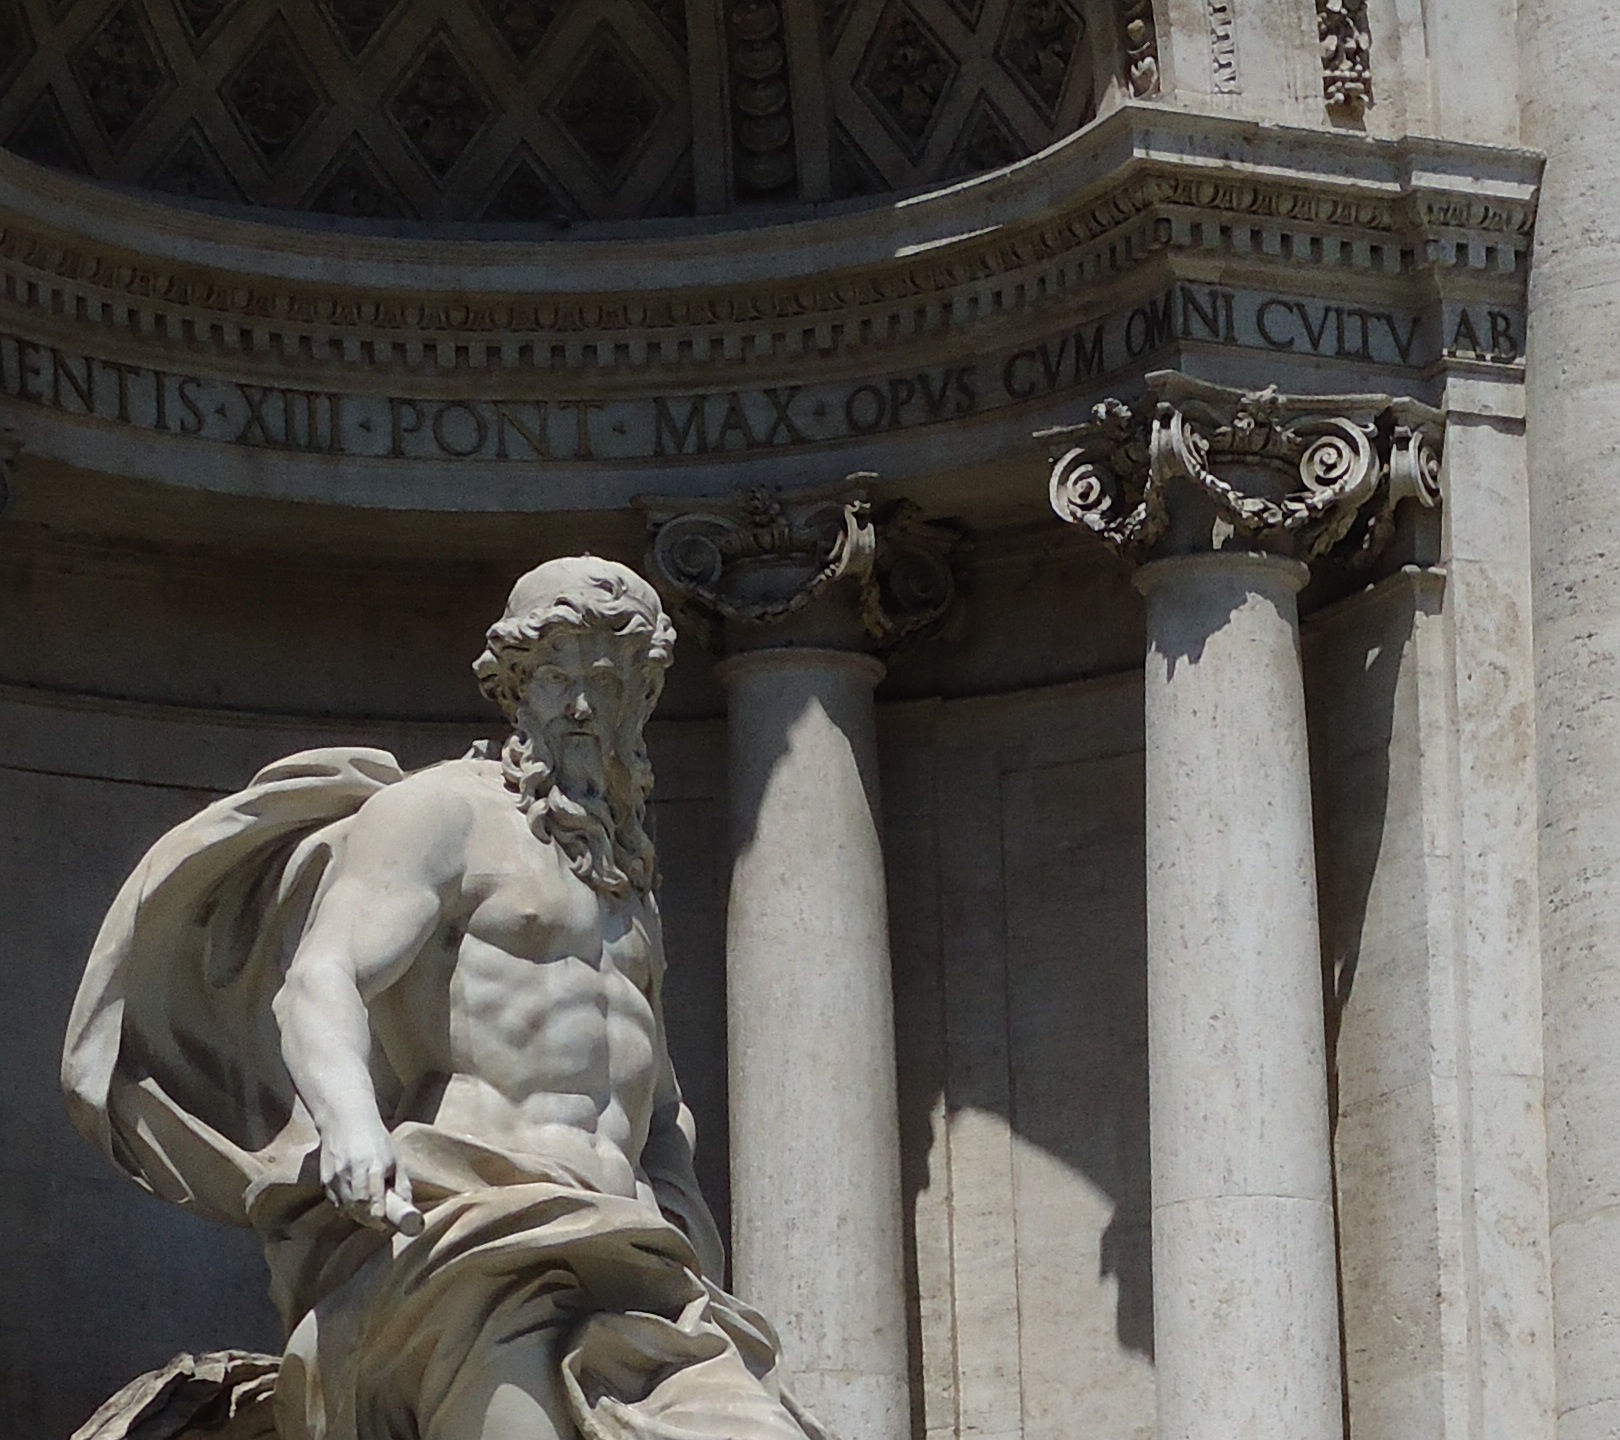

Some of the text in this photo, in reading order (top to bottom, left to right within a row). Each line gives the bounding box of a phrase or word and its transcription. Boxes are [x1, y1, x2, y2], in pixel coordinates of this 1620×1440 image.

[0, 286, 1517, 461] ENTIS XIII PONT MAX OPVS CVM OMNI CVLTV AB
